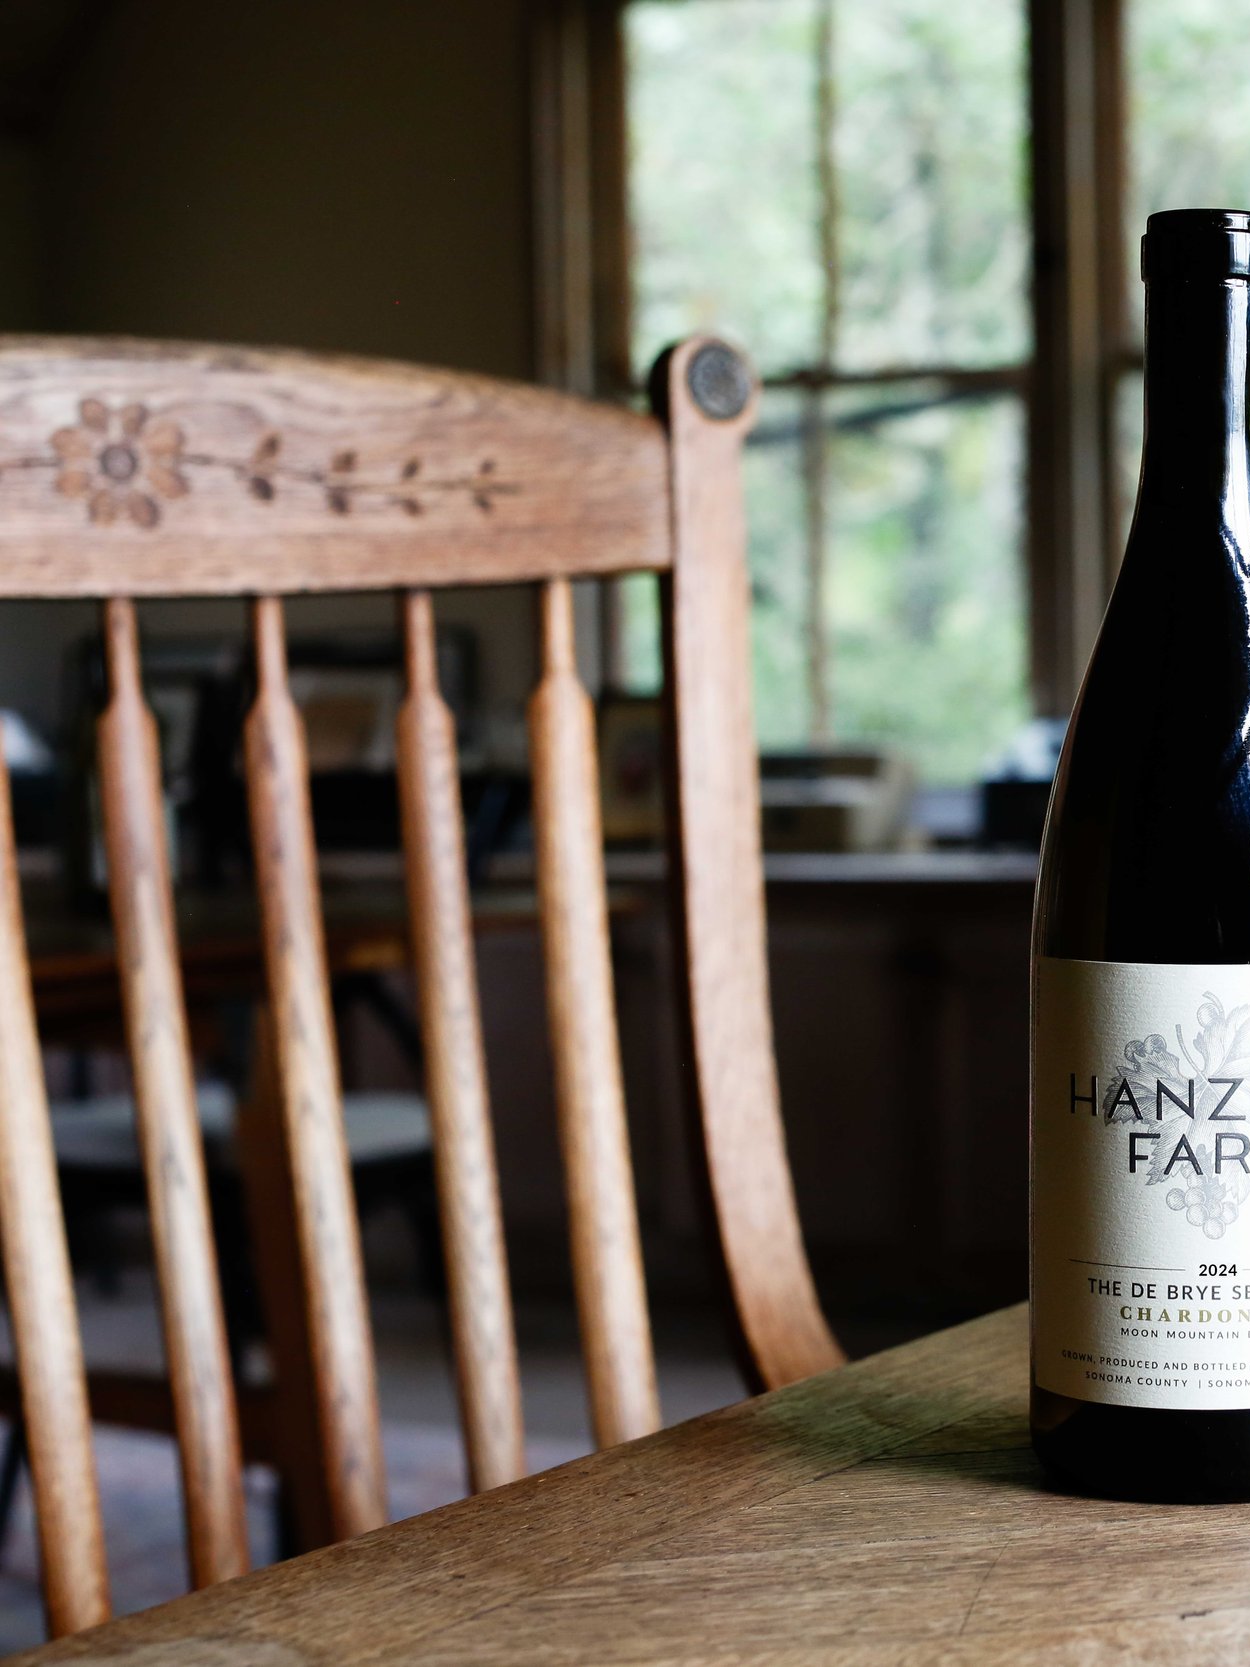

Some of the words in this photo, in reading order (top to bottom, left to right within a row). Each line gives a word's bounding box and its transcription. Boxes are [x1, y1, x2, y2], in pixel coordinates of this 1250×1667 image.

[1199, 1264, 1238, 1276] 2024
[1088, 1278, 1122, 1297] THE
[1131, 1282, 1157, 1299] DE
[1167, 1285, 1222, 1301] BRYE
[1120, 1327, 1158, 1338] MOON
[1166, 1331, 1240, 1340] MOUNTAIN
[1061, 1350, 1096, 1365] GROWN,
[1100, 1356, 1159, 1370] PRODUCED
[1163, 1362, 1188, 1371] AND
[1193, 1362, 1247, 1371] BOTTLED
[1085, 1371, 1132, 1384] SONOMA
[1137, 1377, 1188, 1388] COUNTY
